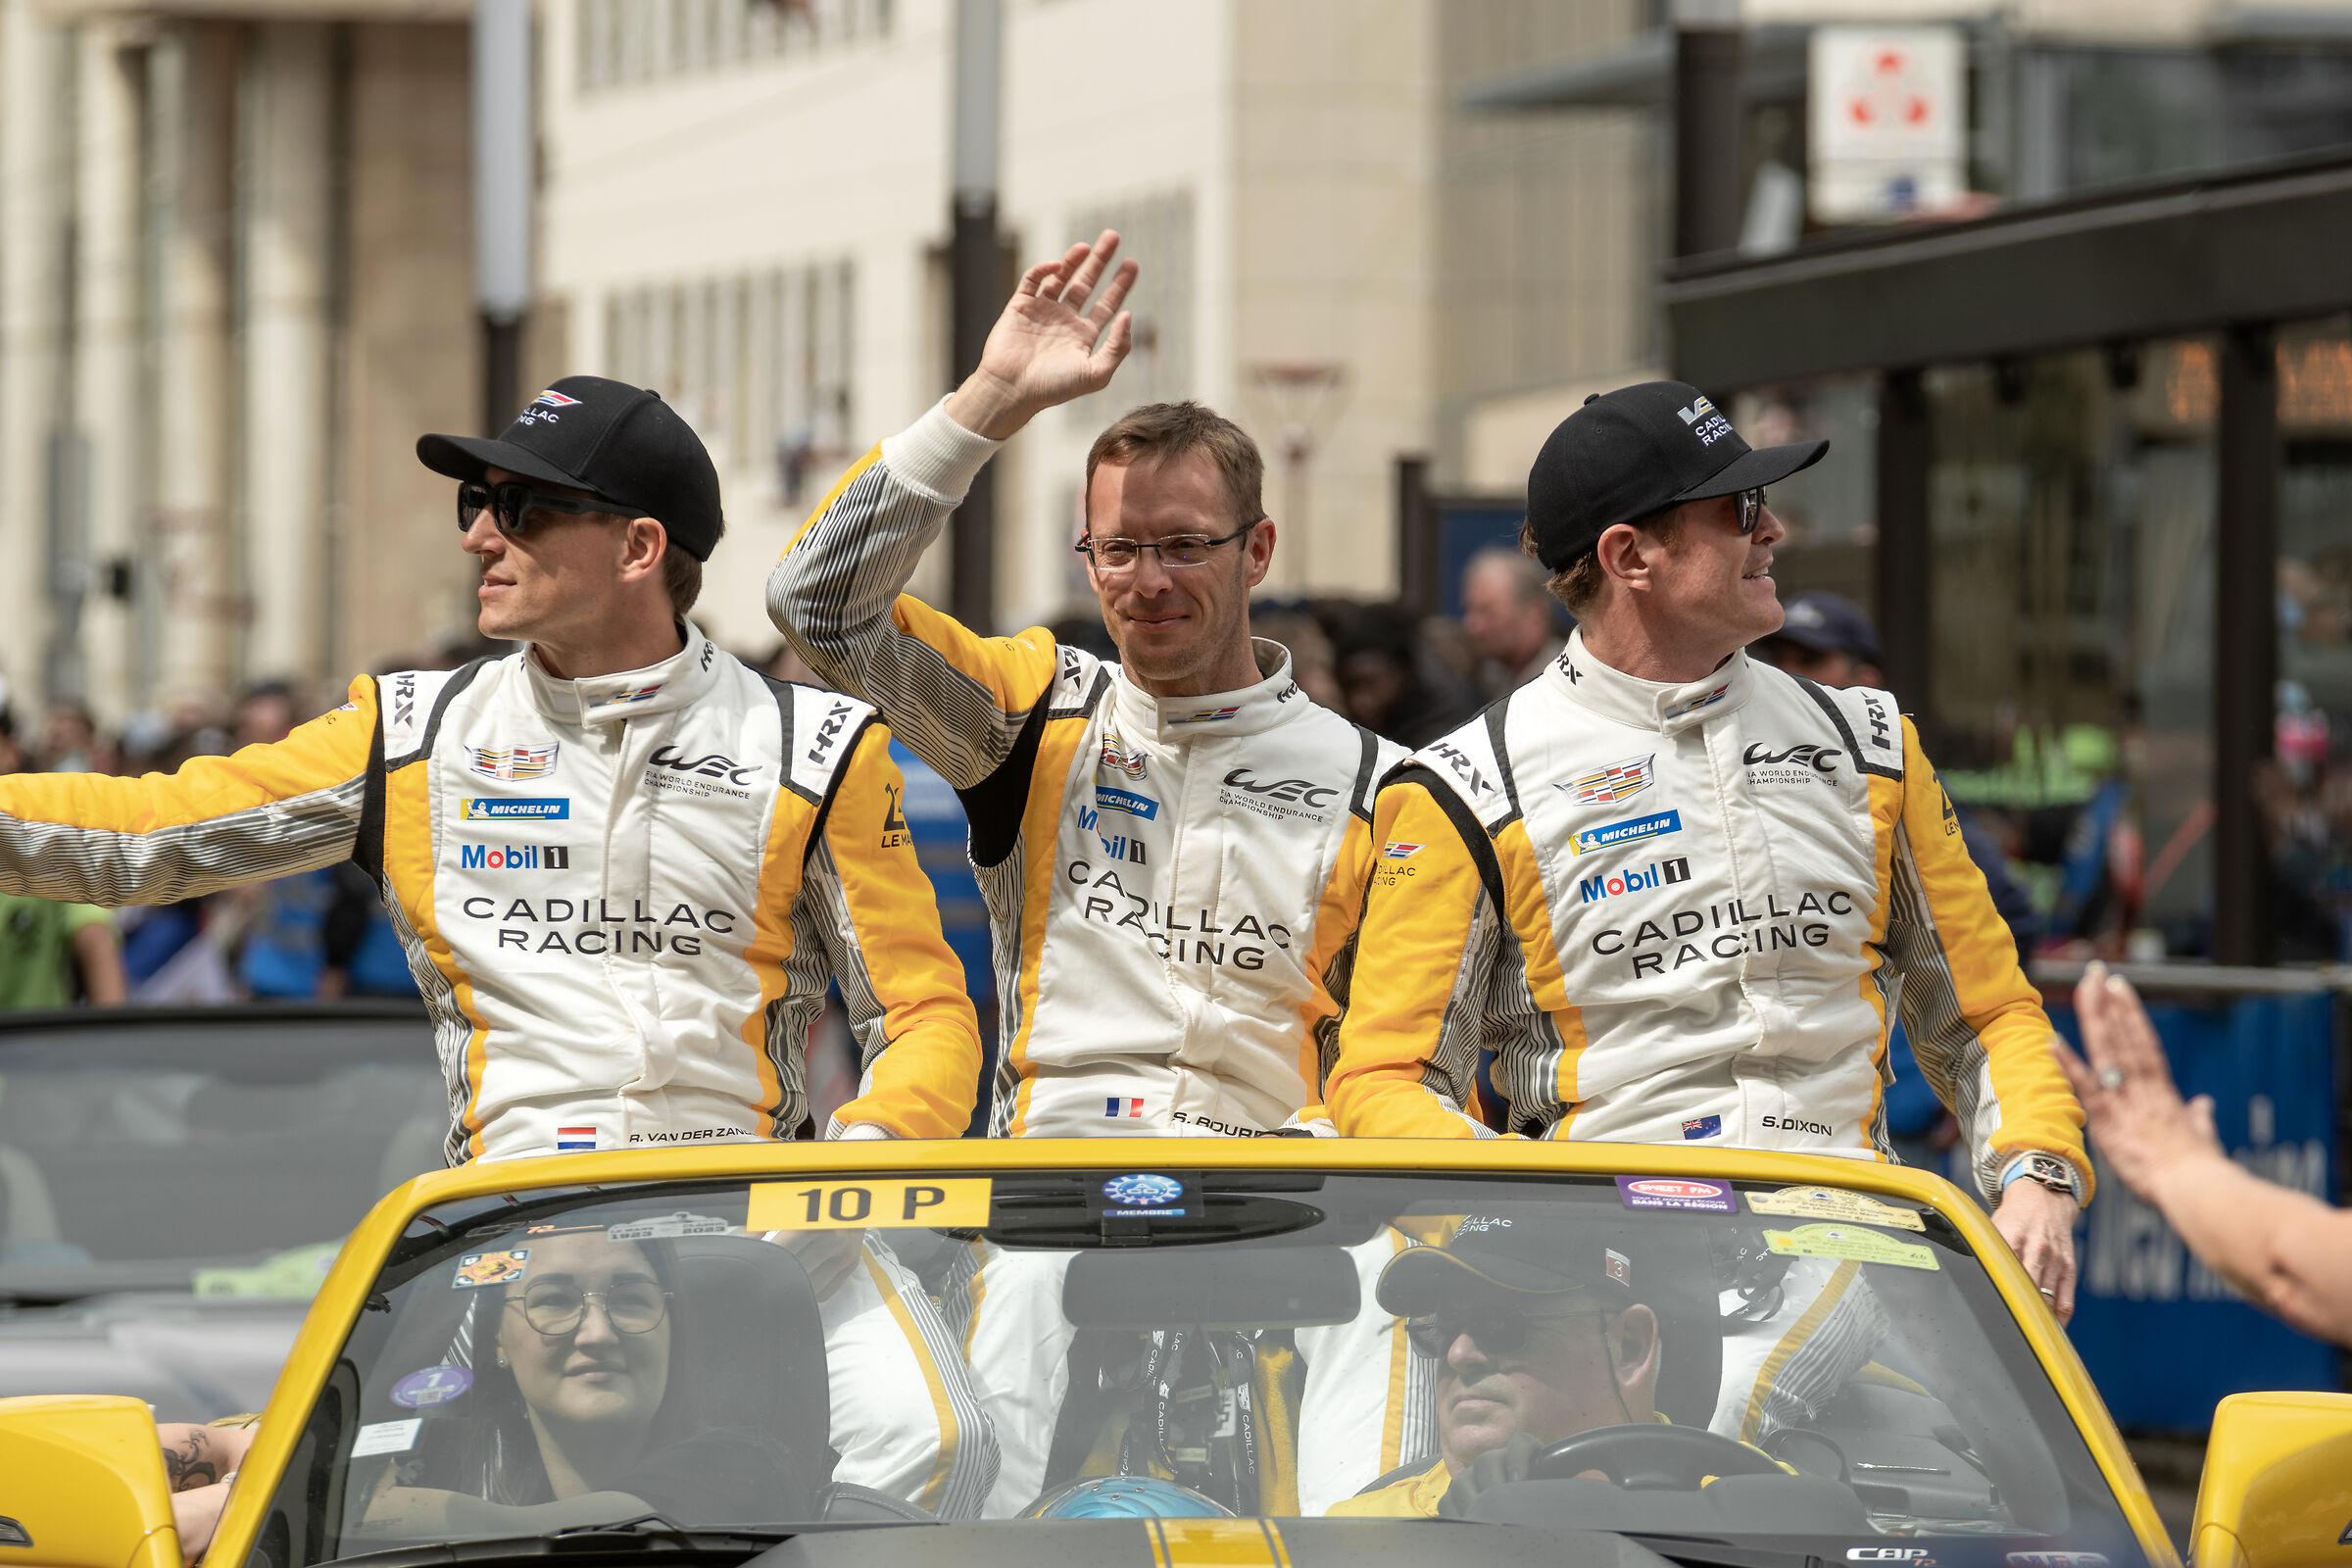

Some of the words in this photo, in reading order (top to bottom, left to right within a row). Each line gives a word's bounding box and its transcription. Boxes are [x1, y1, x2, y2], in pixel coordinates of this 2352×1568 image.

[394, 673, 415, 730] HRX
[808, 700, 854, 765] HRX
[1427, 742, 1495, 797] HRX
[644, 778, 710, 798] CHAMPIONSHIP
[646, 770, 658, 779] FIA
[660, 773, 693, 787] WORLD
[695, 781, 751, 799] ENDURANCE
[490, 805, 562, 814] MICHELIN
[1219, 796, 1285, 821] CHAMPIONSHIP
[1220, 788, 1232, 798] FIA
[1234, 793, 1267, 808] WORLD
[1267, 804, 1324, 823] ENDURANCE
[881, 834, 901, 848] LE
[1600, 817, 1671, 843] MICHELIN
[462, 844, 538, 869] Mobil
[1580, 862, 1660, 904] Mobil
[463, 897, 736, 933] CADILLAC
[1592, 891, 1853, 956] CADILLAC
[498, 928, 702, 956] RACING
[1632, 923, 1830, 979] RACING
[629, 1134, 644, 1143] R.
[647, 1132, 679, 1142] VAN
[681, 1129, 713, 1141] DER
[1761, 1115, 1833, 1137] S.DIXON
[797, 1187, 872, 1222] 10
[902, 1186, 946, 1220] P
[1614, 1260, 1624, 1277] 3
[427, 1372, 444, 1388] 1
[1242, 1414, 1255, 1475] CADILLAC
